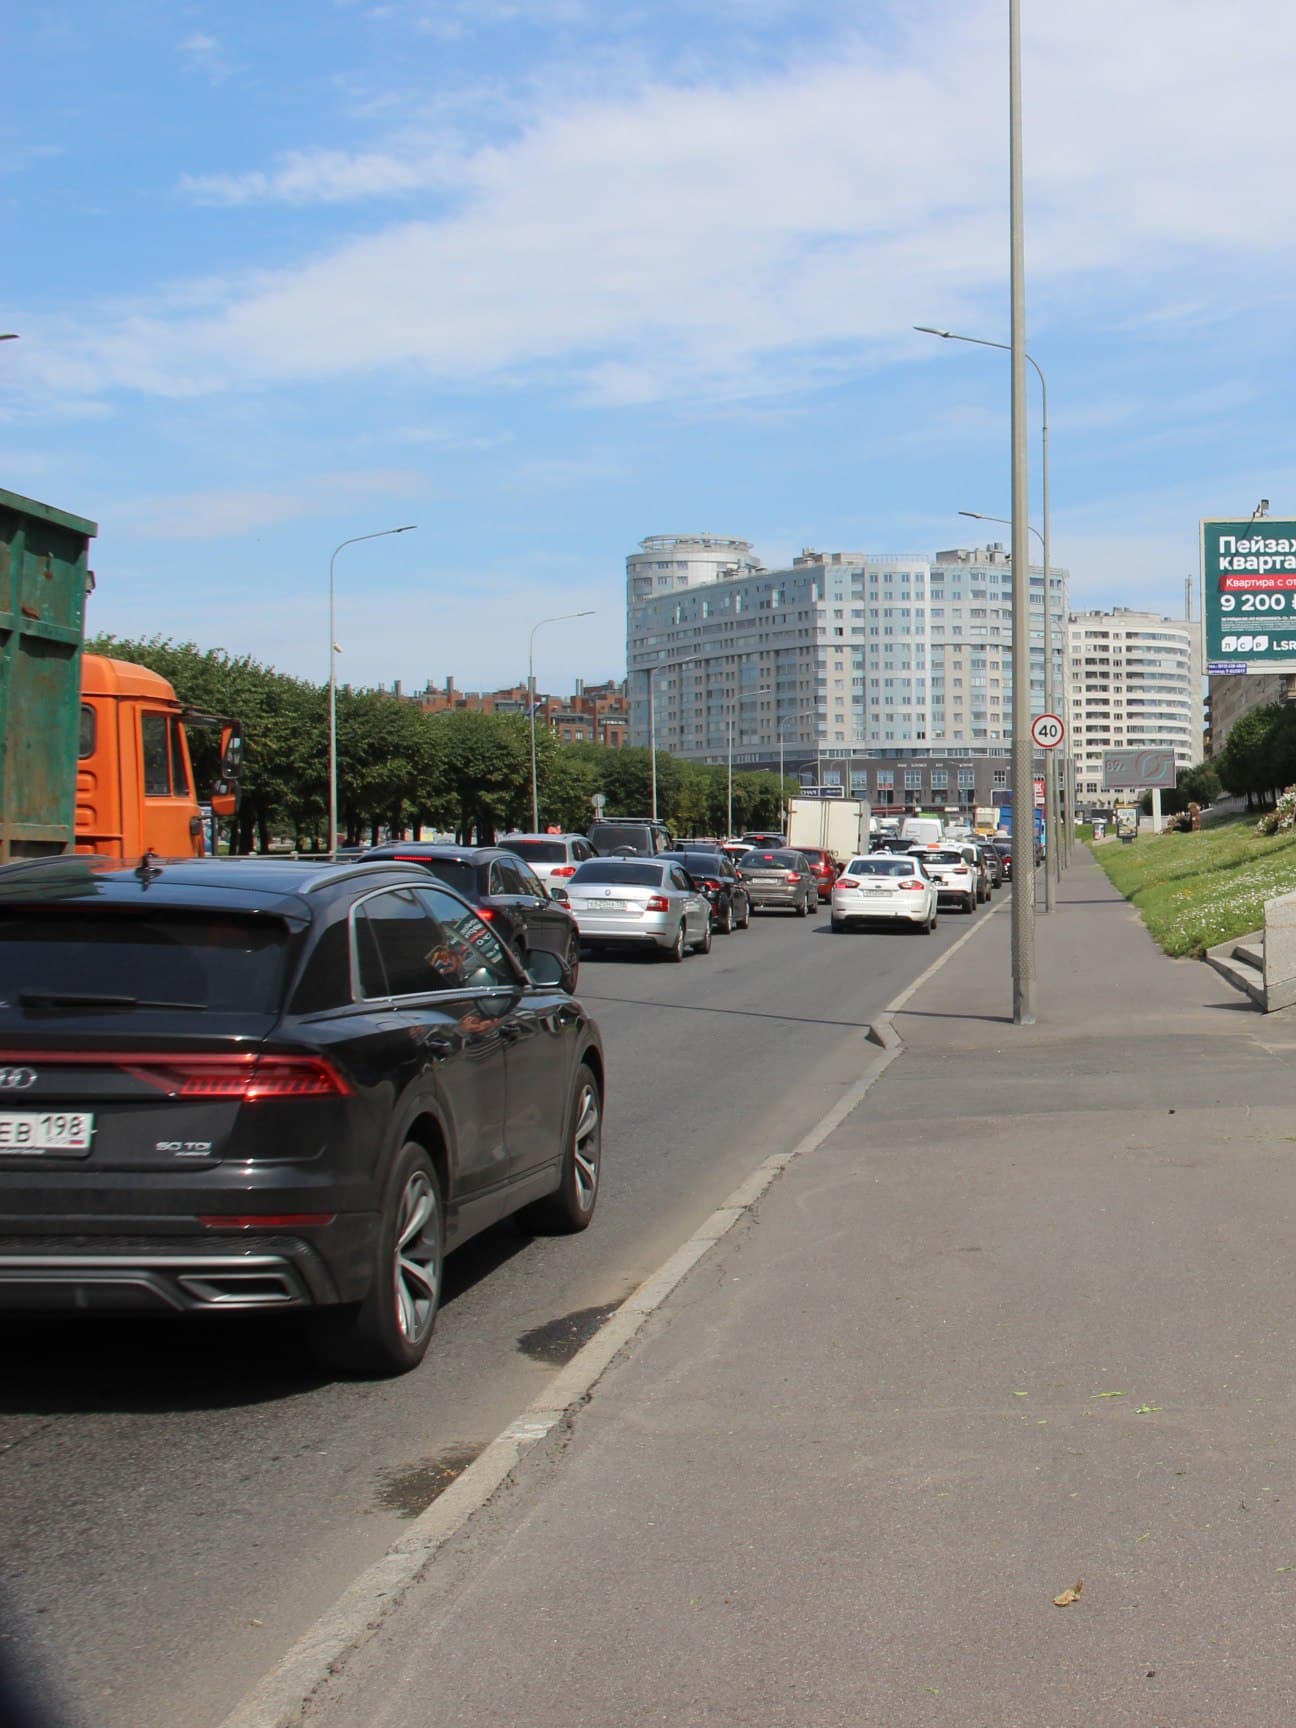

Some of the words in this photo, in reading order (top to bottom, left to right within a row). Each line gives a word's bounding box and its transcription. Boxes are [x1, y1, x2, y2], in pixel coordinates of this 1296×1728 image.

[1226, 578, 1275, 589] Квартира
[1220, 594, 1236, 611] 9
[1241, 593, 1286, 611] 200
[1038, 724, 1058, 738] 40
[41, 1115, 83, 1136] 198
